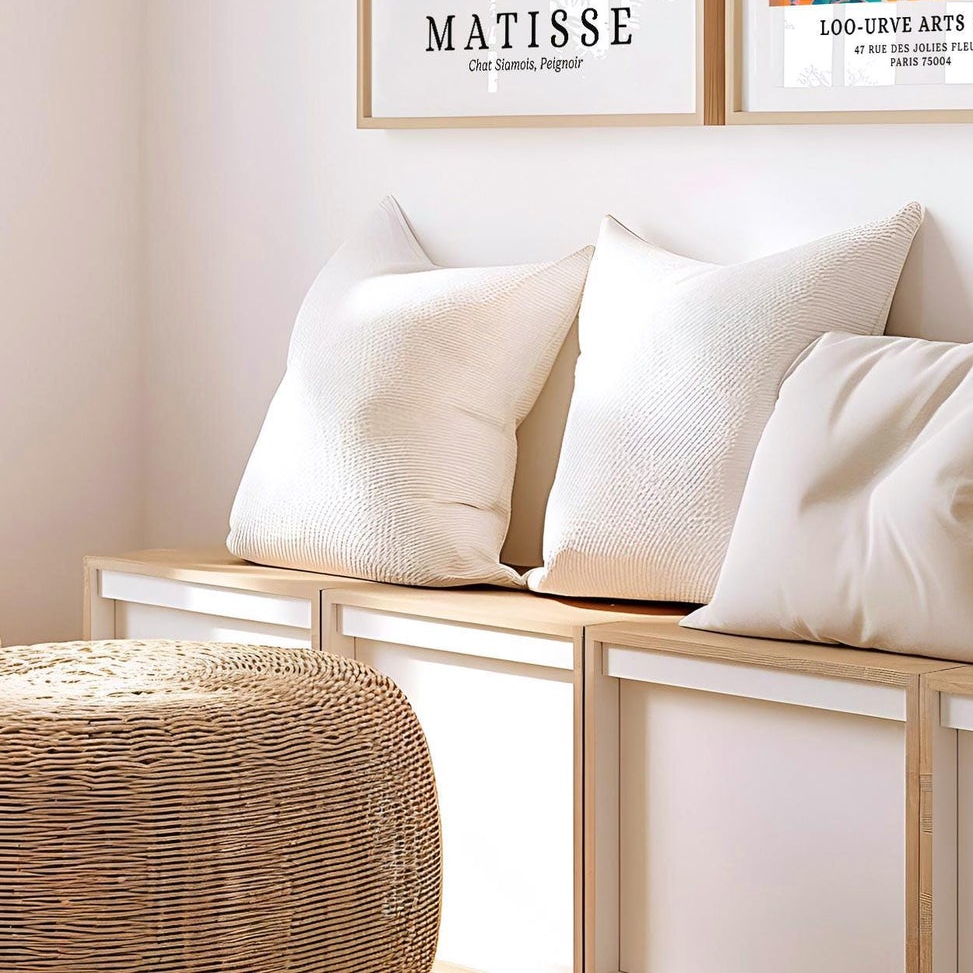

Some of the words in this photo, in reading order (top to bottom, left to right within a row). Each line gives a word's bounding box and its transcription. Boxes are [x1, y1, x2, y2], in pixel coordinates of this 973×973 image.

[425, 7, 633, 52] MATISSE
[820, 16, 913, 36] LOO-URVE
[918, 13, 965, 33] ARTS
[854, 44, 865, 55] 47
[868, 44, 887, 54] RUE
[890, 43, 910, 54] DES
[912, 42, 948, 53] JOLIES
[468, 57, 493, 72] Chat
[494, 56, 538, 73] Siamois,
[540, 55, 584, 73] Peignoir
[890, 56, 919, 67] PARIS
[921, 56, 952, 67] 75004
